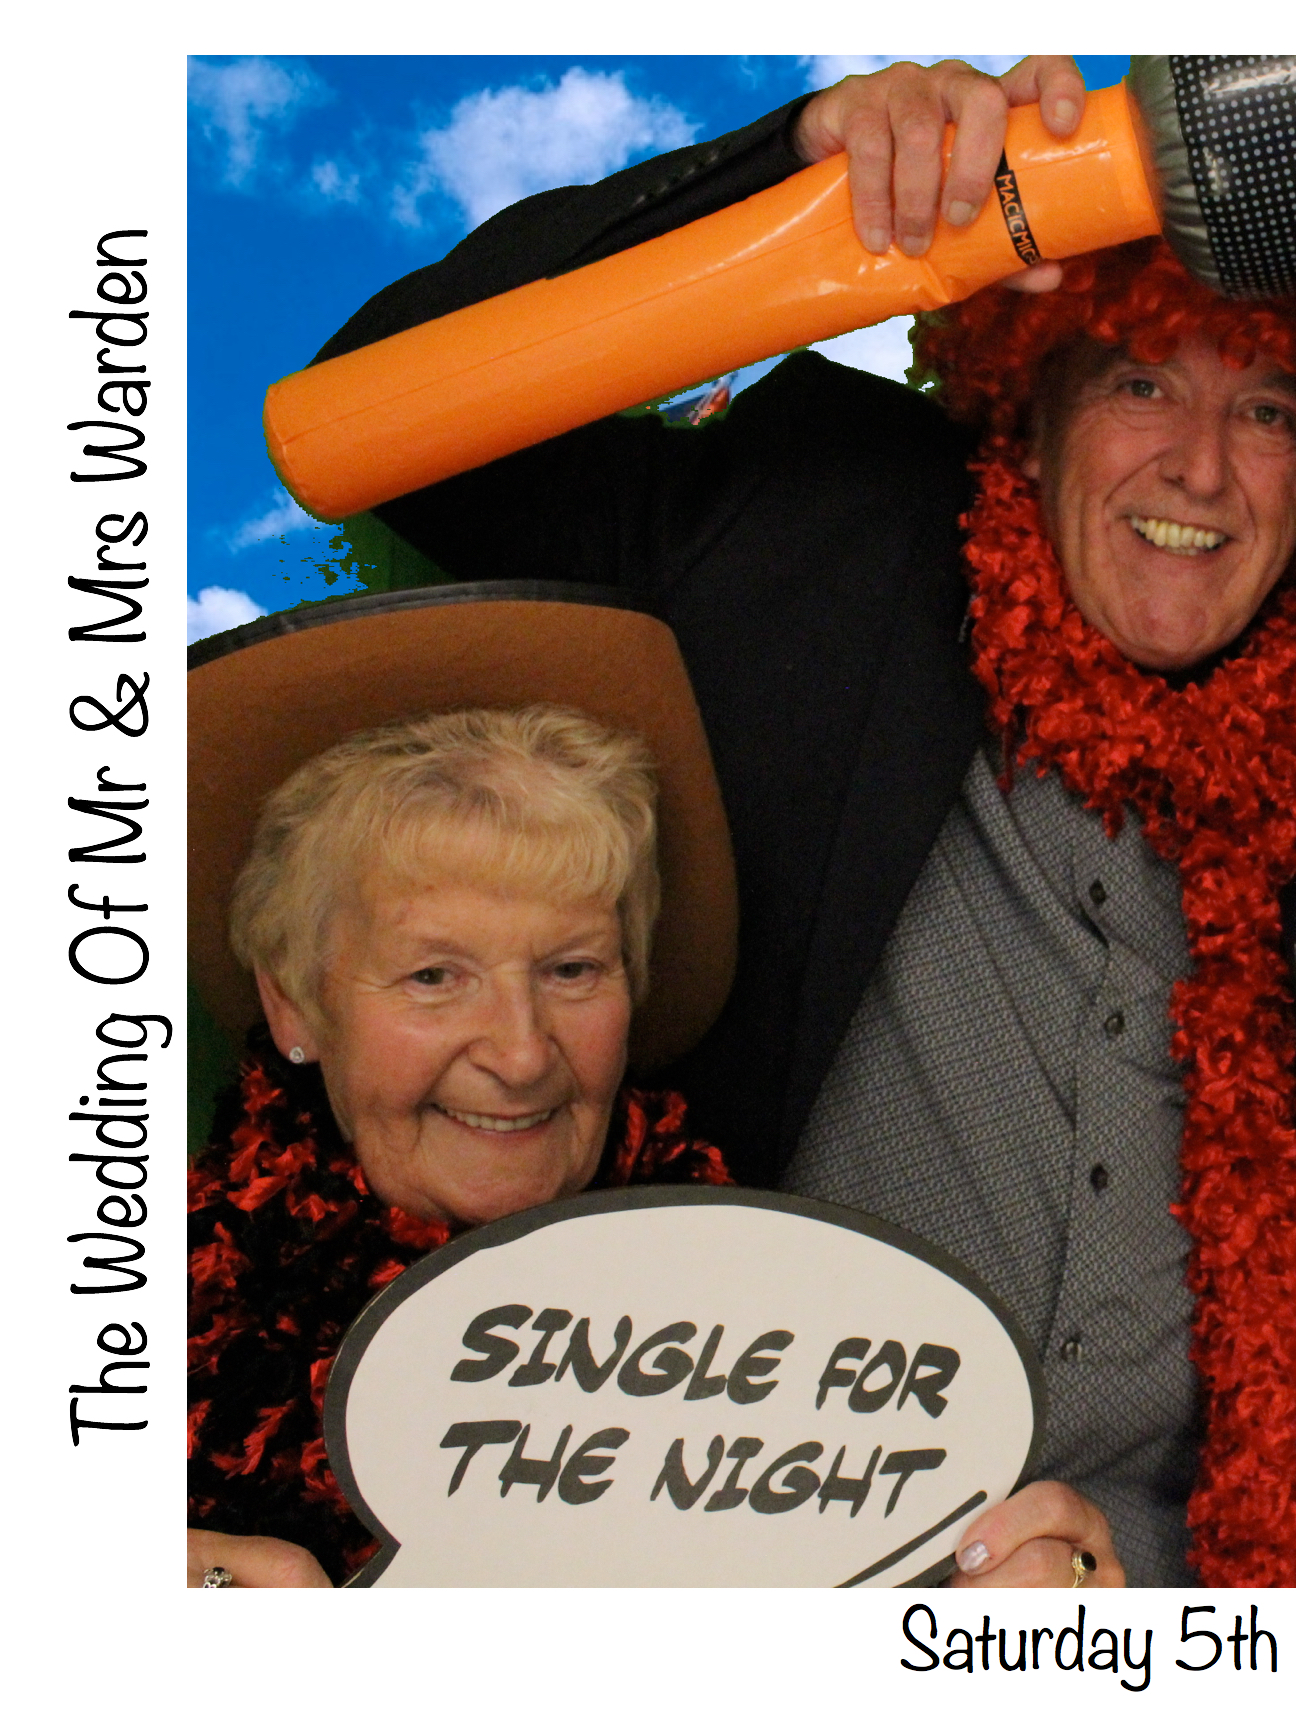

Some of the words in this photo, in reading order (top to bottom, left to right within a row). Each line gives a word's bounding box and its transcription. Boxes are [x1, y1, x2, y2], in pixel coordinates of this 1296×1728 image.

[450, 1304, 795, 1405] SINGLE
[816, 1338, 961, 1419] FOR
[439, 1420, 631, 1506] THE
[650, 1435, 947, 1519] NIGHT
